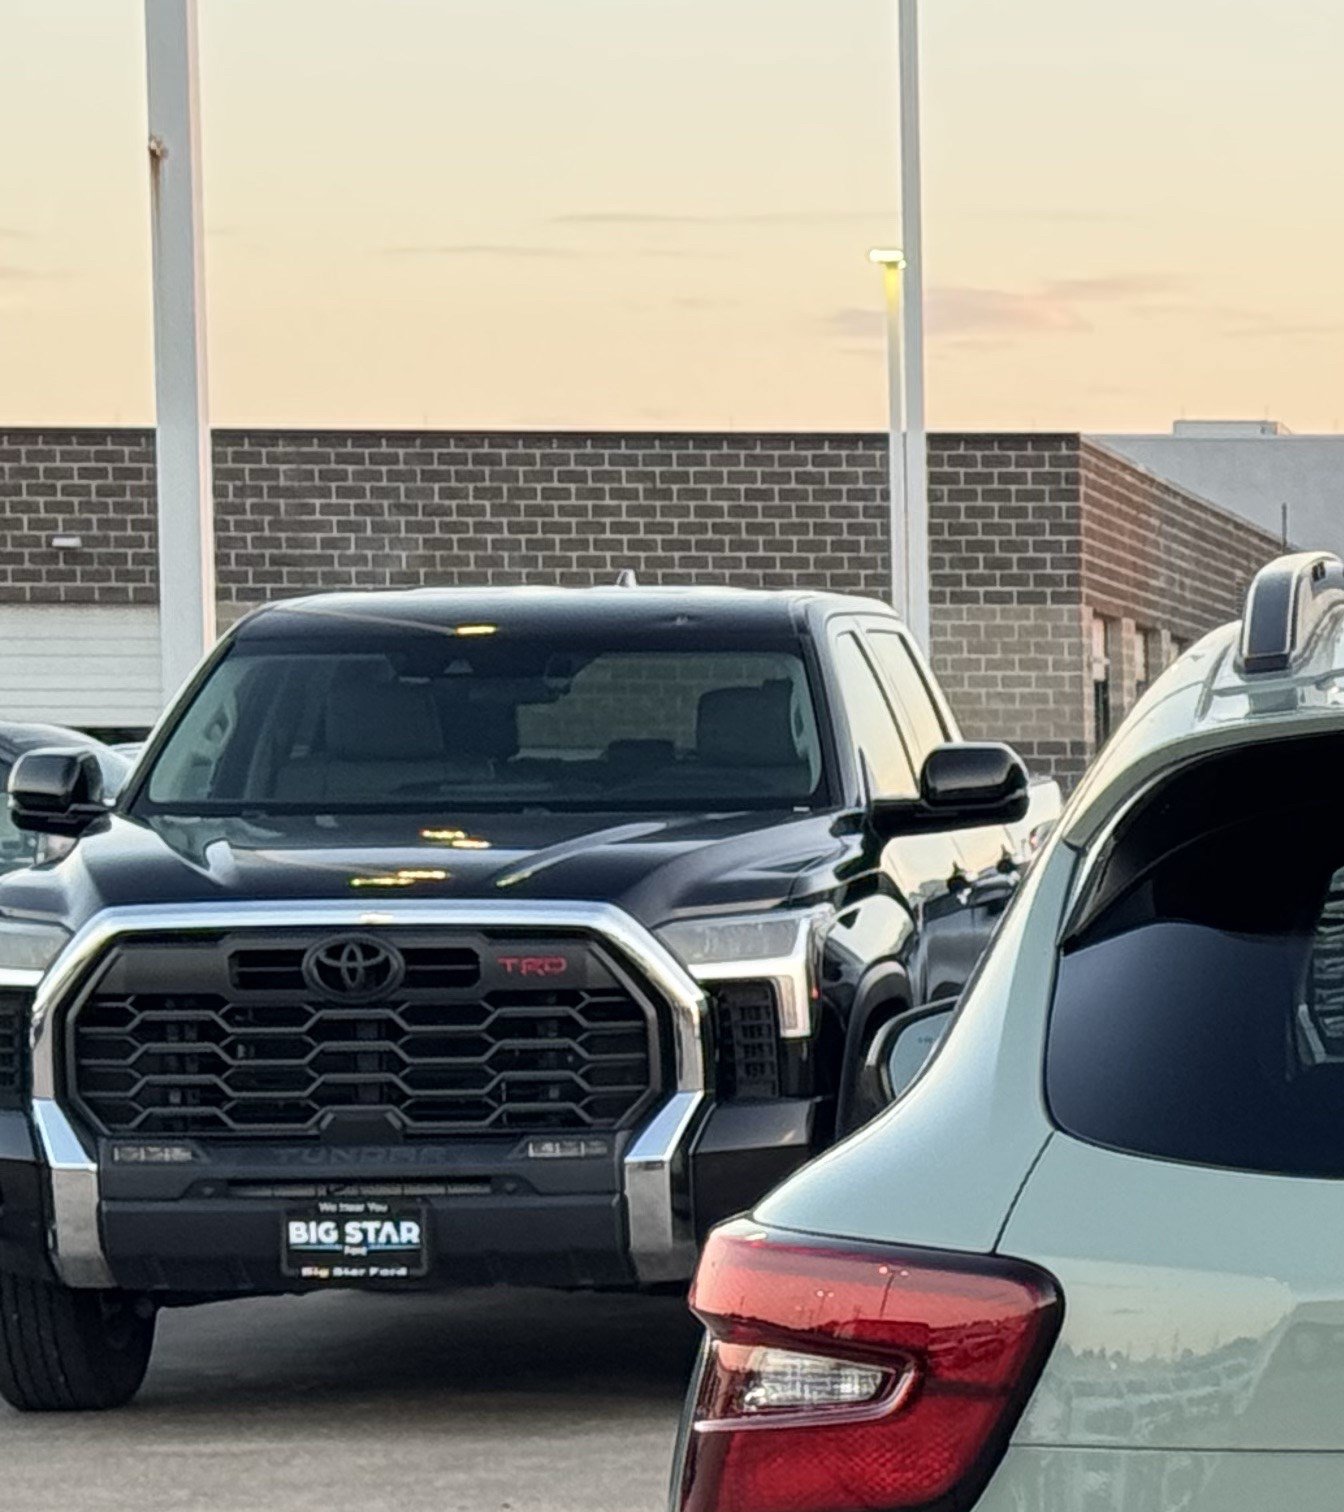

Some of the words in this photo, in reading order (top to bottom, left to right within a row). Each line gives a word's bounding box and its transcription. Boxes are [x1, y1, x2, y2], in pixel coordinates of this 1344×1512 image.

[496, 956, 567, 976] TRD
[288, 1221, 339, 1244] BIG
[344, 1221, 421, 1244] STAR
